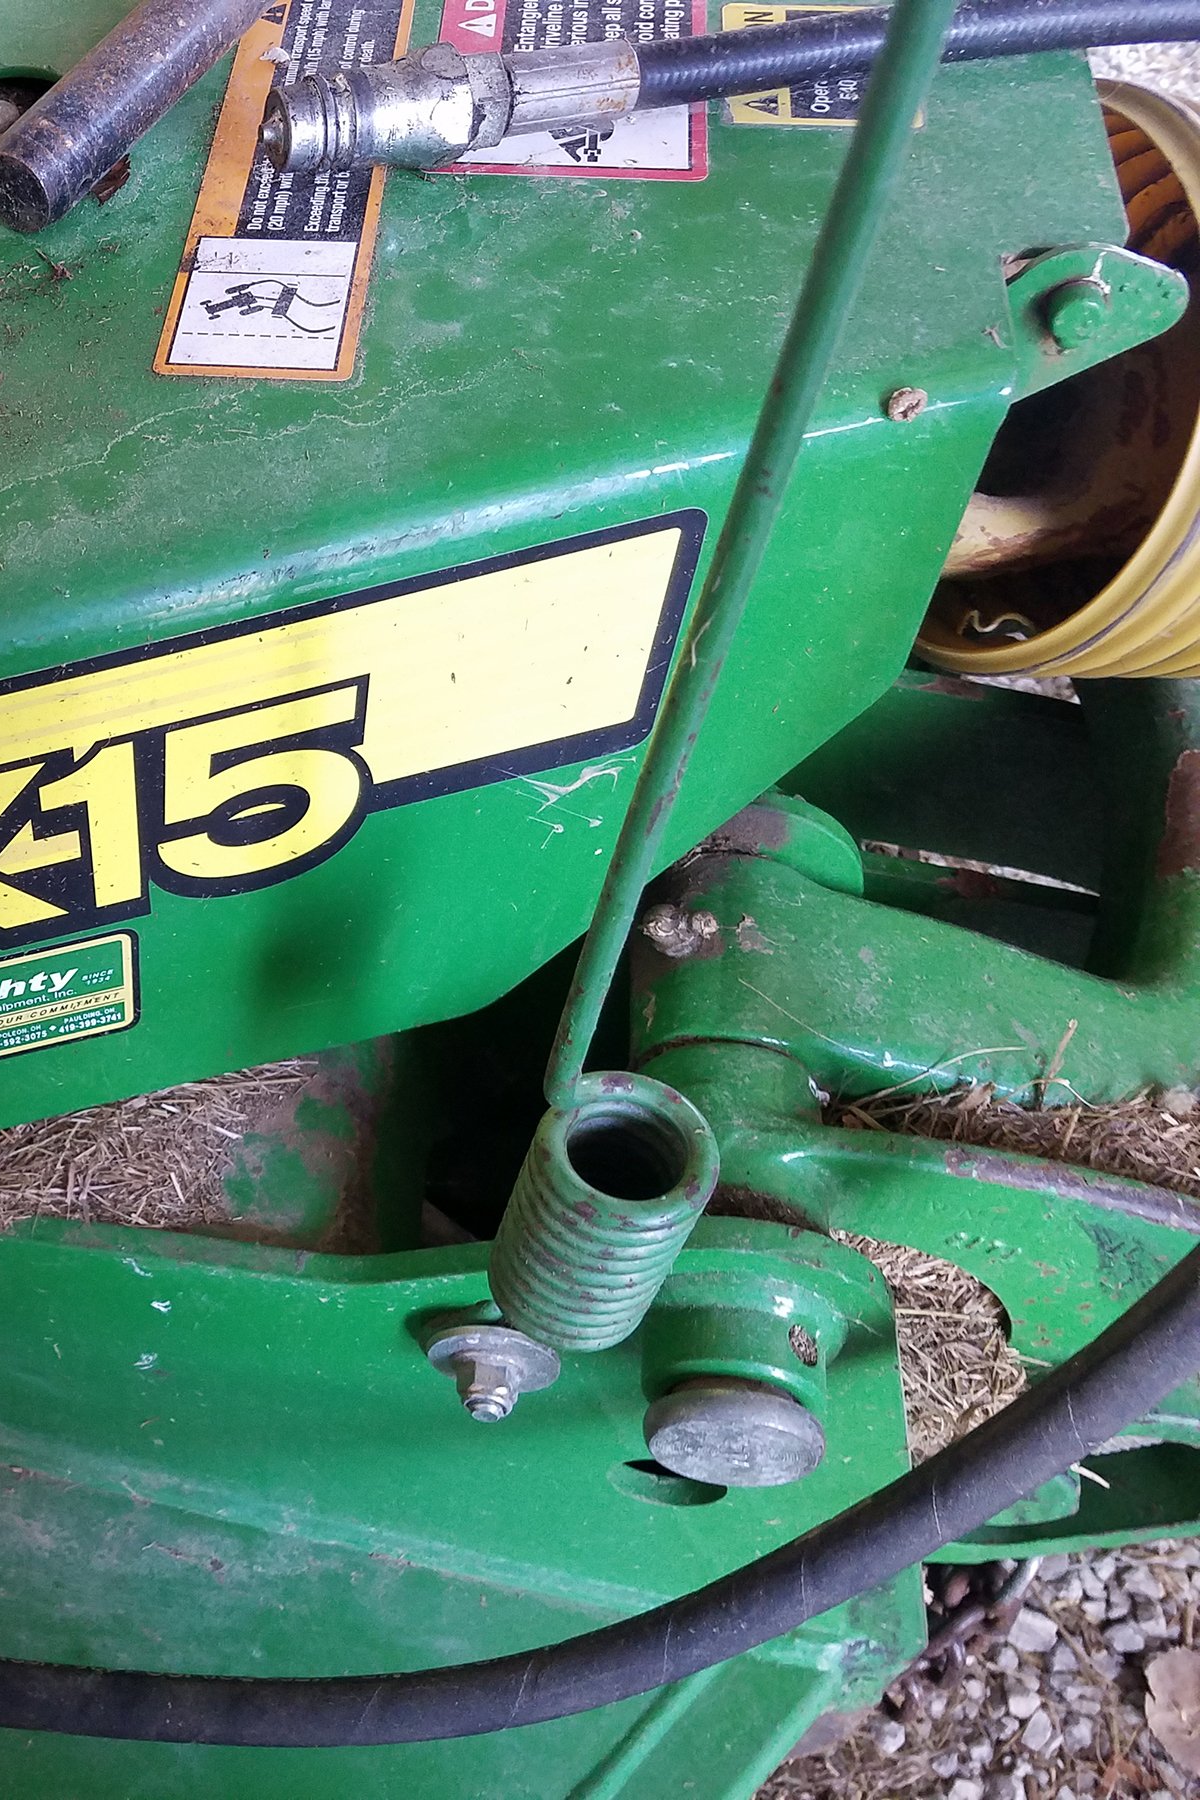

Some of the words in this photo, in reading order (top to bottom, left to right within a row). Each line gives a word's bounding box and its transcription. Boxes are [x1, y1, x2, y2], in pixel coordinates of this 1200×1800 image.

[299, 3, 314, 24] speed
[315, 11, 330, 27] with
[346, 9, 366, 32] during
[601, 7, 622, 20] all
[566, 10, 589, 45] erious
[342, 32, 358, 59] control
[358, 39, 376, 63] death.
[338, 61, 353, 70] of
[253, 199, 269, 216] not
[273, 190, 293, 214] mph)
[303, 185, 331, 231] Exceeding
[324, 190, 348, 232] transport
[336, 179, 350, 191] or
[246, 217, 264, 231] Do
[266, 215, 286, 231] (20
[81, 968, 114, 981] SINCE
[54, 988, 78, 999] Inc.
[30, 992, 120, 1019] COMMITMENT
[30, 1024, 42, 1032] OH
[58, 1012, 122, 1034] 419-399-3741
